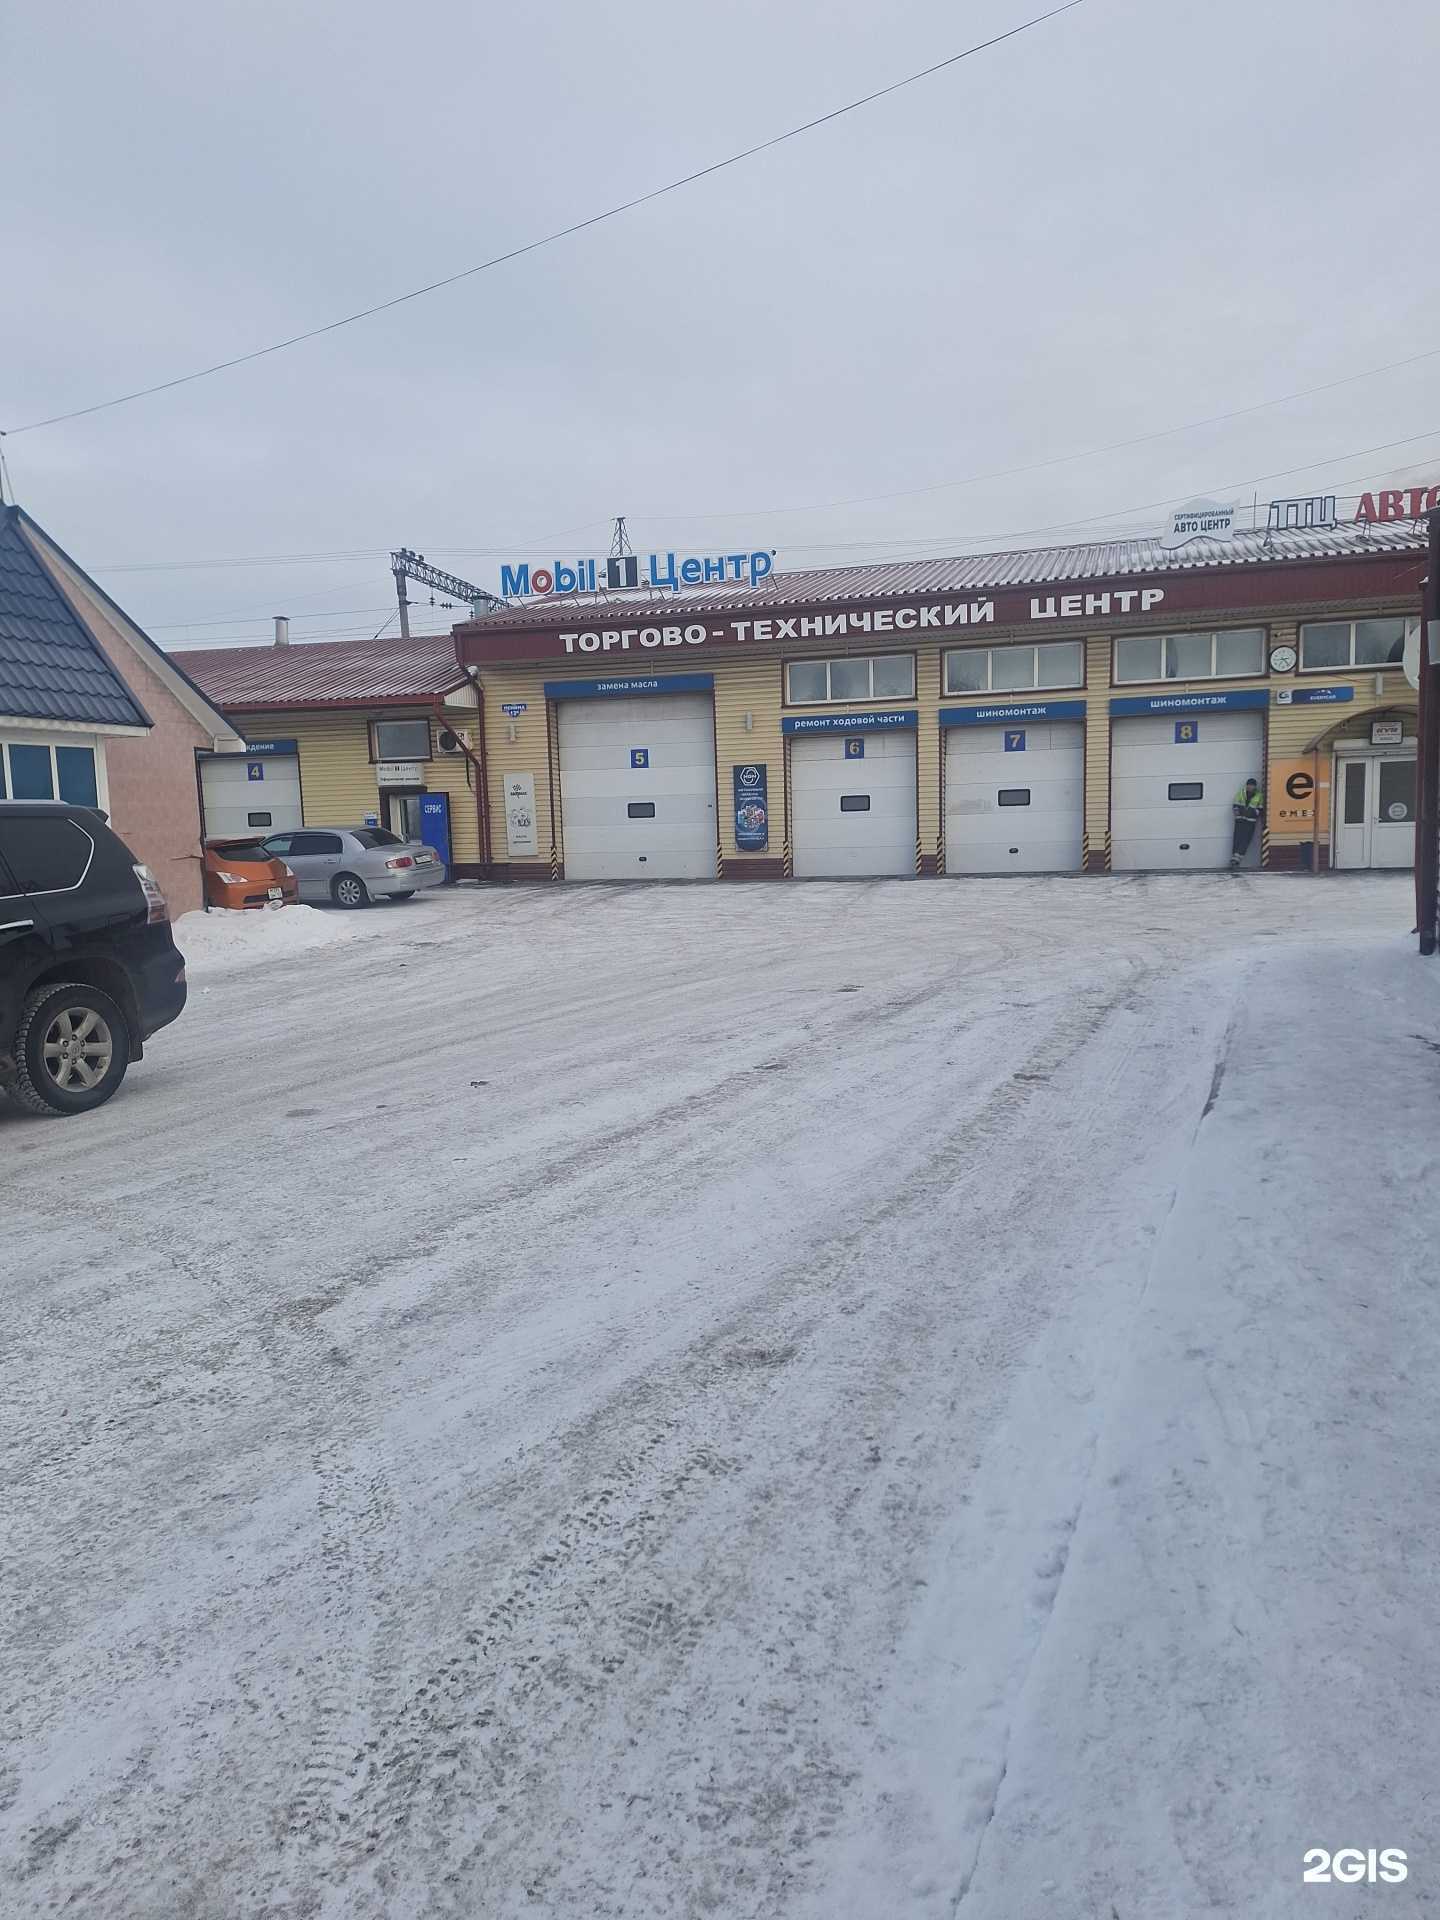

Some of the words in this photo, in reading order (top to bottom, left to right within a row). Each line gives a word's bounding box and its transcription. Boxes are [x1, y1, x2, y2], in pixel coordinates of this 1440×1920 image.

[1173, 508, 1235, 521] СЕРТИФИЦИРОВАННЫЙ
[1270, 495, 1337, 531] ТТЦ
[1173, 520, 1199, 534] АВТО
[1200, 518, 1232, 533] ЦЕНТР
[500, 558, 598, 599] Mobil
[649, 550, 773, 595] Центр
[559, 624, 708, 653] ТОРГОВО
[730, 596, 995, 642] ТЕХНИЧЕСКИЙ
[1030, 588, 1166, 620] ЦЕНТР
[597, 681, 629, 691] замена
[630, 680, 658, 689] масла
[1150, 696, 1227, 708] шиномонтаж
[976, 706, 1047, 718] шиномонтаж
[794, 718, 831, 730] ремонт
[832, 714, 875, 727] ходовой
[877, 714, 905, 723] части
[1180, 725, 1193, 740] 8
[849, 741, 860, 755] 6
[1009, 734, 1021, 748] 7
[635, 752, 645, 765] 5
[250, 765, 261, 779] 4
